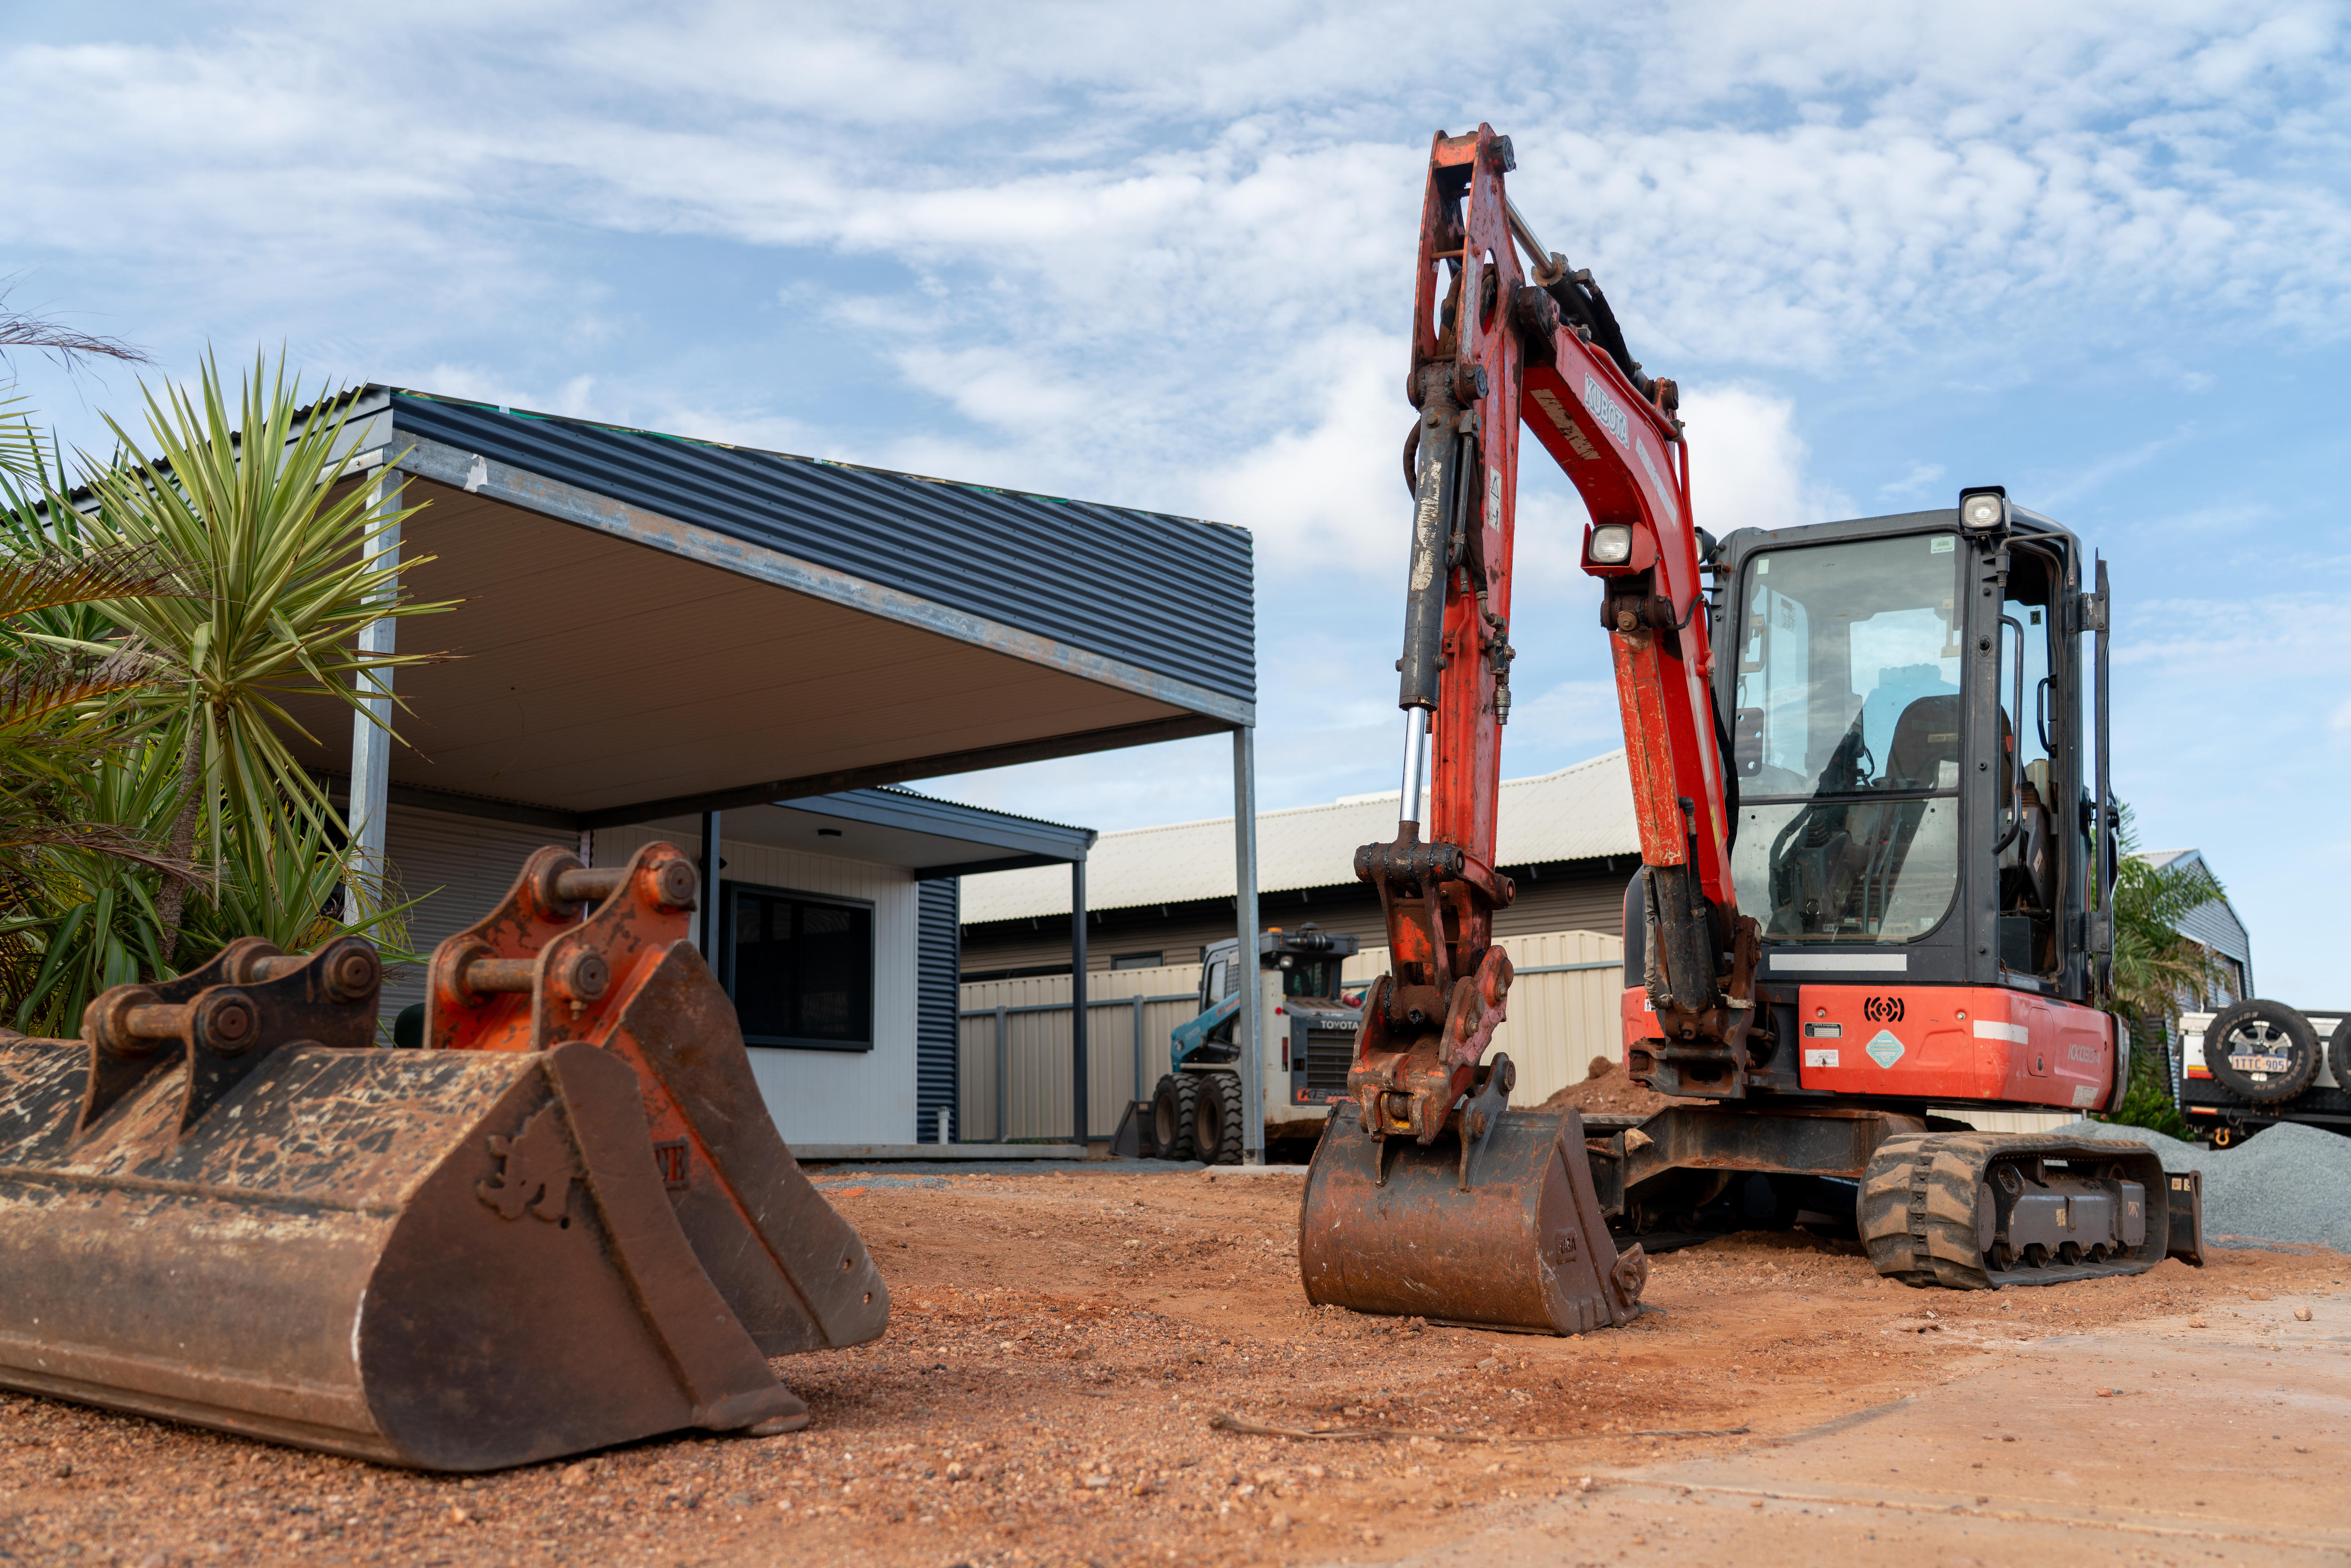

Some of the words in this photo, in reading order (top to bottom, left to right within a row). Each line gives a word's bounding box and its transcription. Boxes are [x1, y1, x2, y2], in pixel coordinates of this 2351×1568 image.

[1585, 374, 1629, 449] KUBOTA
[1321, 1020, 1358, 1030] TOYOTA
[2067, 1043, 2101, 1065] KX033-4
